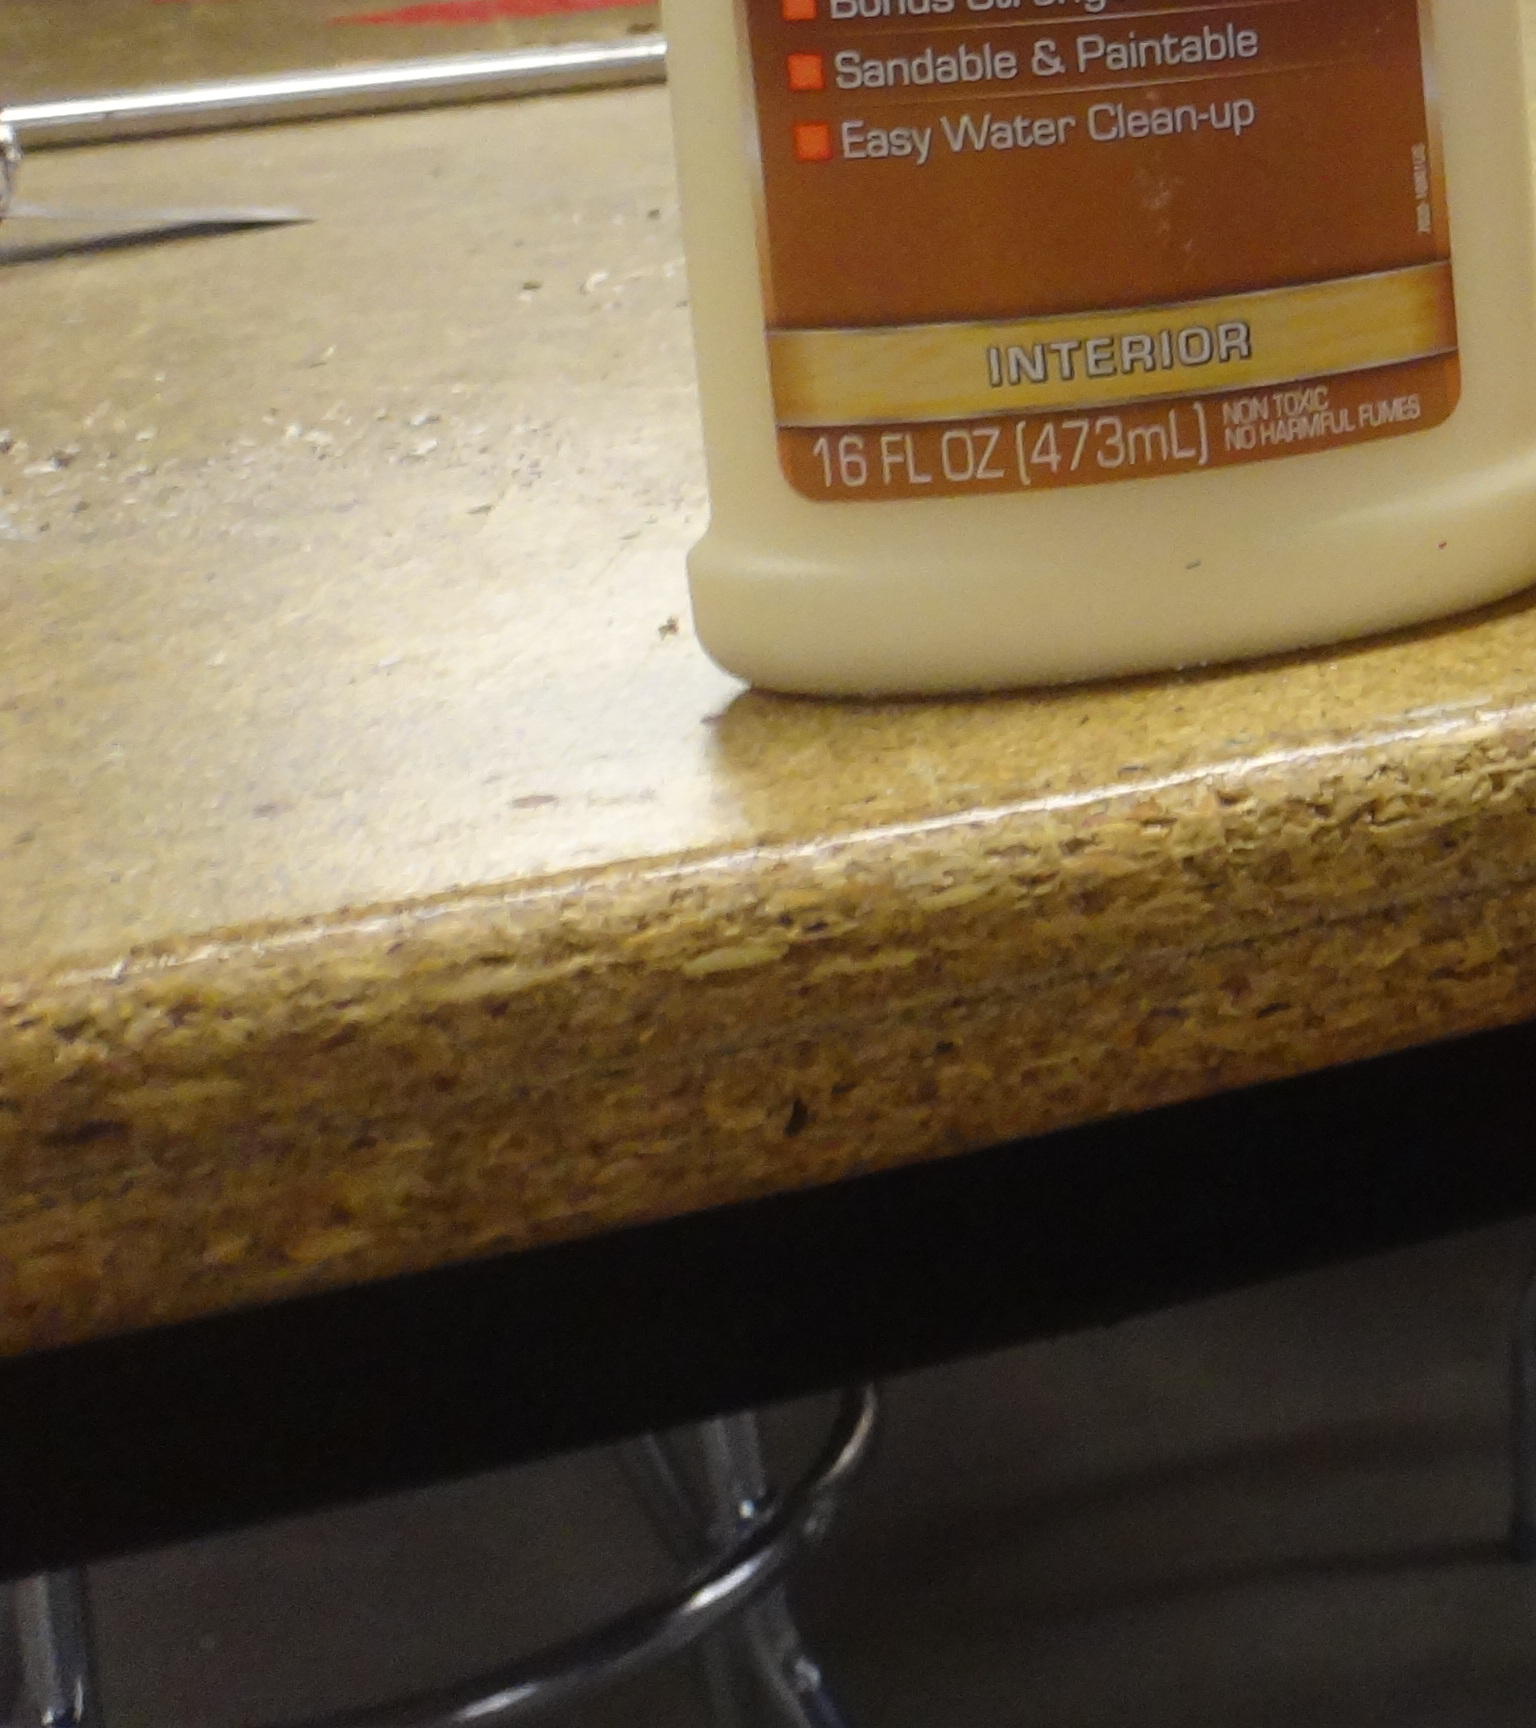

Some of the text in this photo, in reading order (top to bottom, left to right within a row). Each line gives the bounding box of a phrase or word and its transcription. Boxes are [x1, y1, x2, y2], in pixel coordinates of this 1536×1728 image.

[834, 24, 1260, 91] Sandable & Paintable
[840, 95, 1257, 165] Easy Water Clean-up
[987, 321, 1252, 387] INTERIOR
[1224, 394, 1421, 452] NO HARMFUL FUMES
[1273, 385, 1329, 417] TOXIC
[812, 433, 867, 488] 16
[880, 433, 933, 485] FL
[941, 427, 1005, 482] OZ
